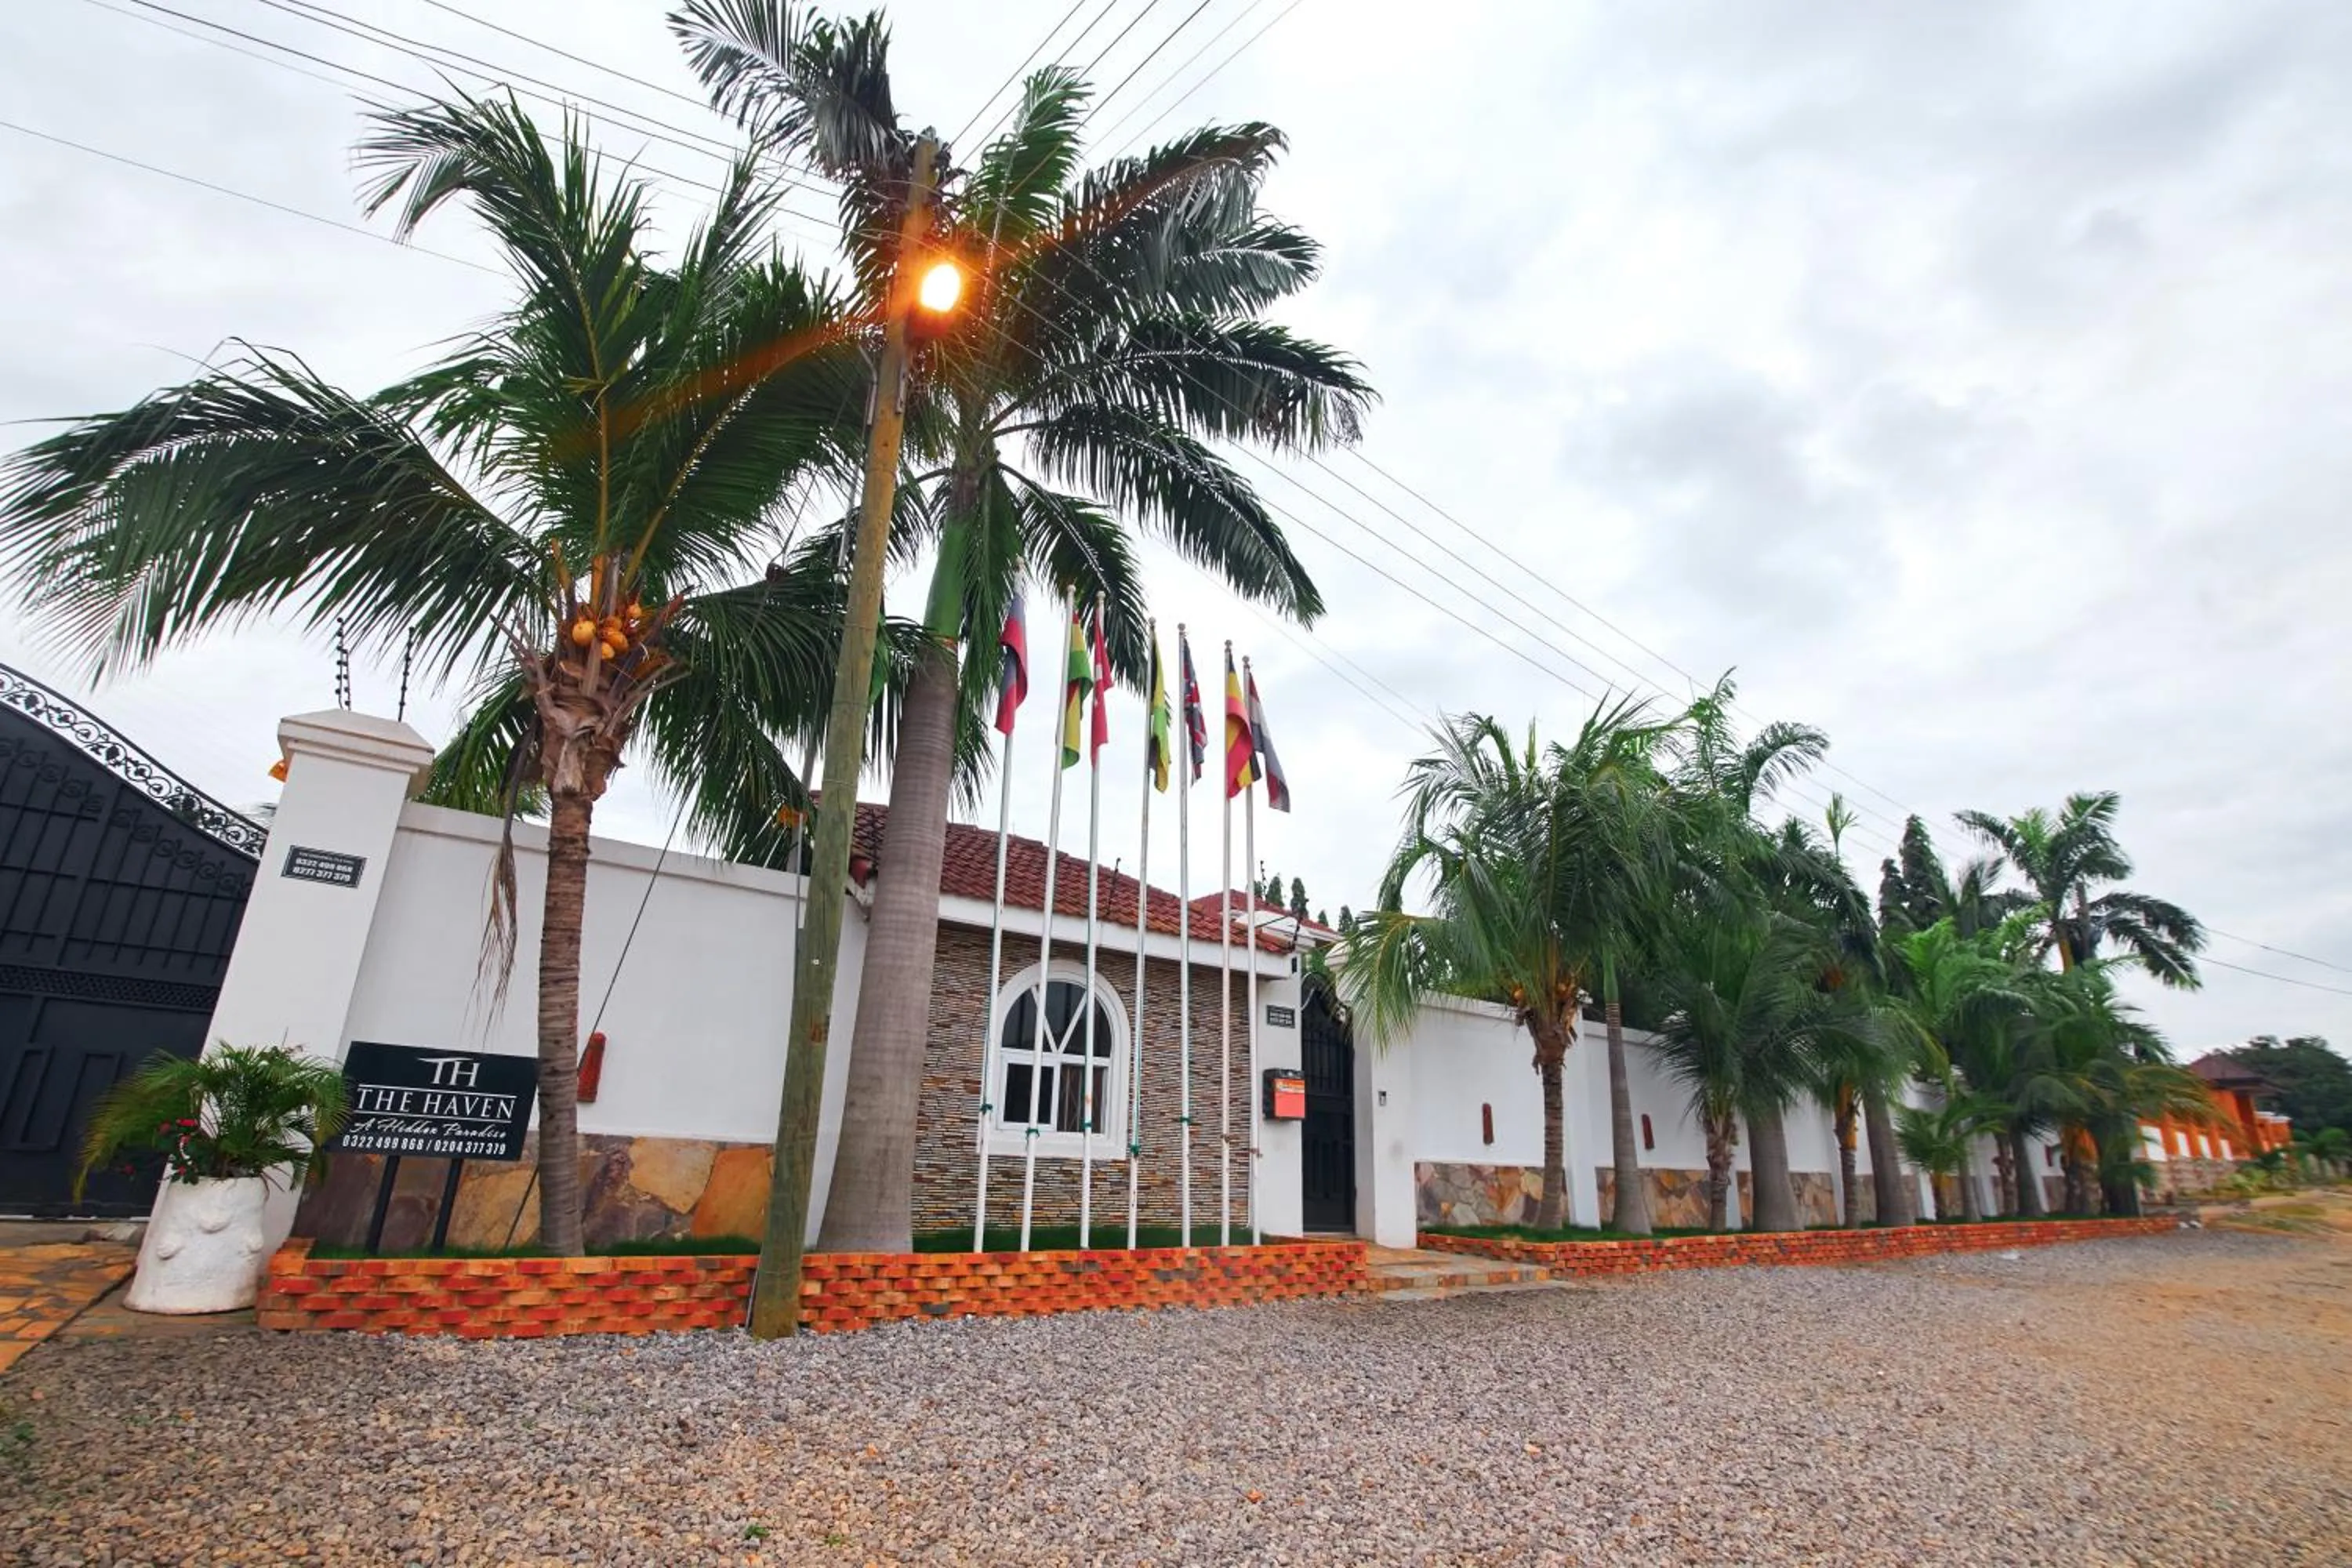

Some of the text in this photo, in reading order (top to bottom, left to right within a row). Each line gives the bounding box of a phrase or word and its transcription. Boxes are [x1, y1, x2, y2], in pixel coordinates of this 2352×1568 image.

[416, 1058, 481, 1087] TH
[356, 1087, 515, 1119] THE HAVEN
[350, 1118, 506, 1138] A Hidden Paradise
[343, 1134, 374, 1149] 0322
[465, 1141, 485, 1153] 377
